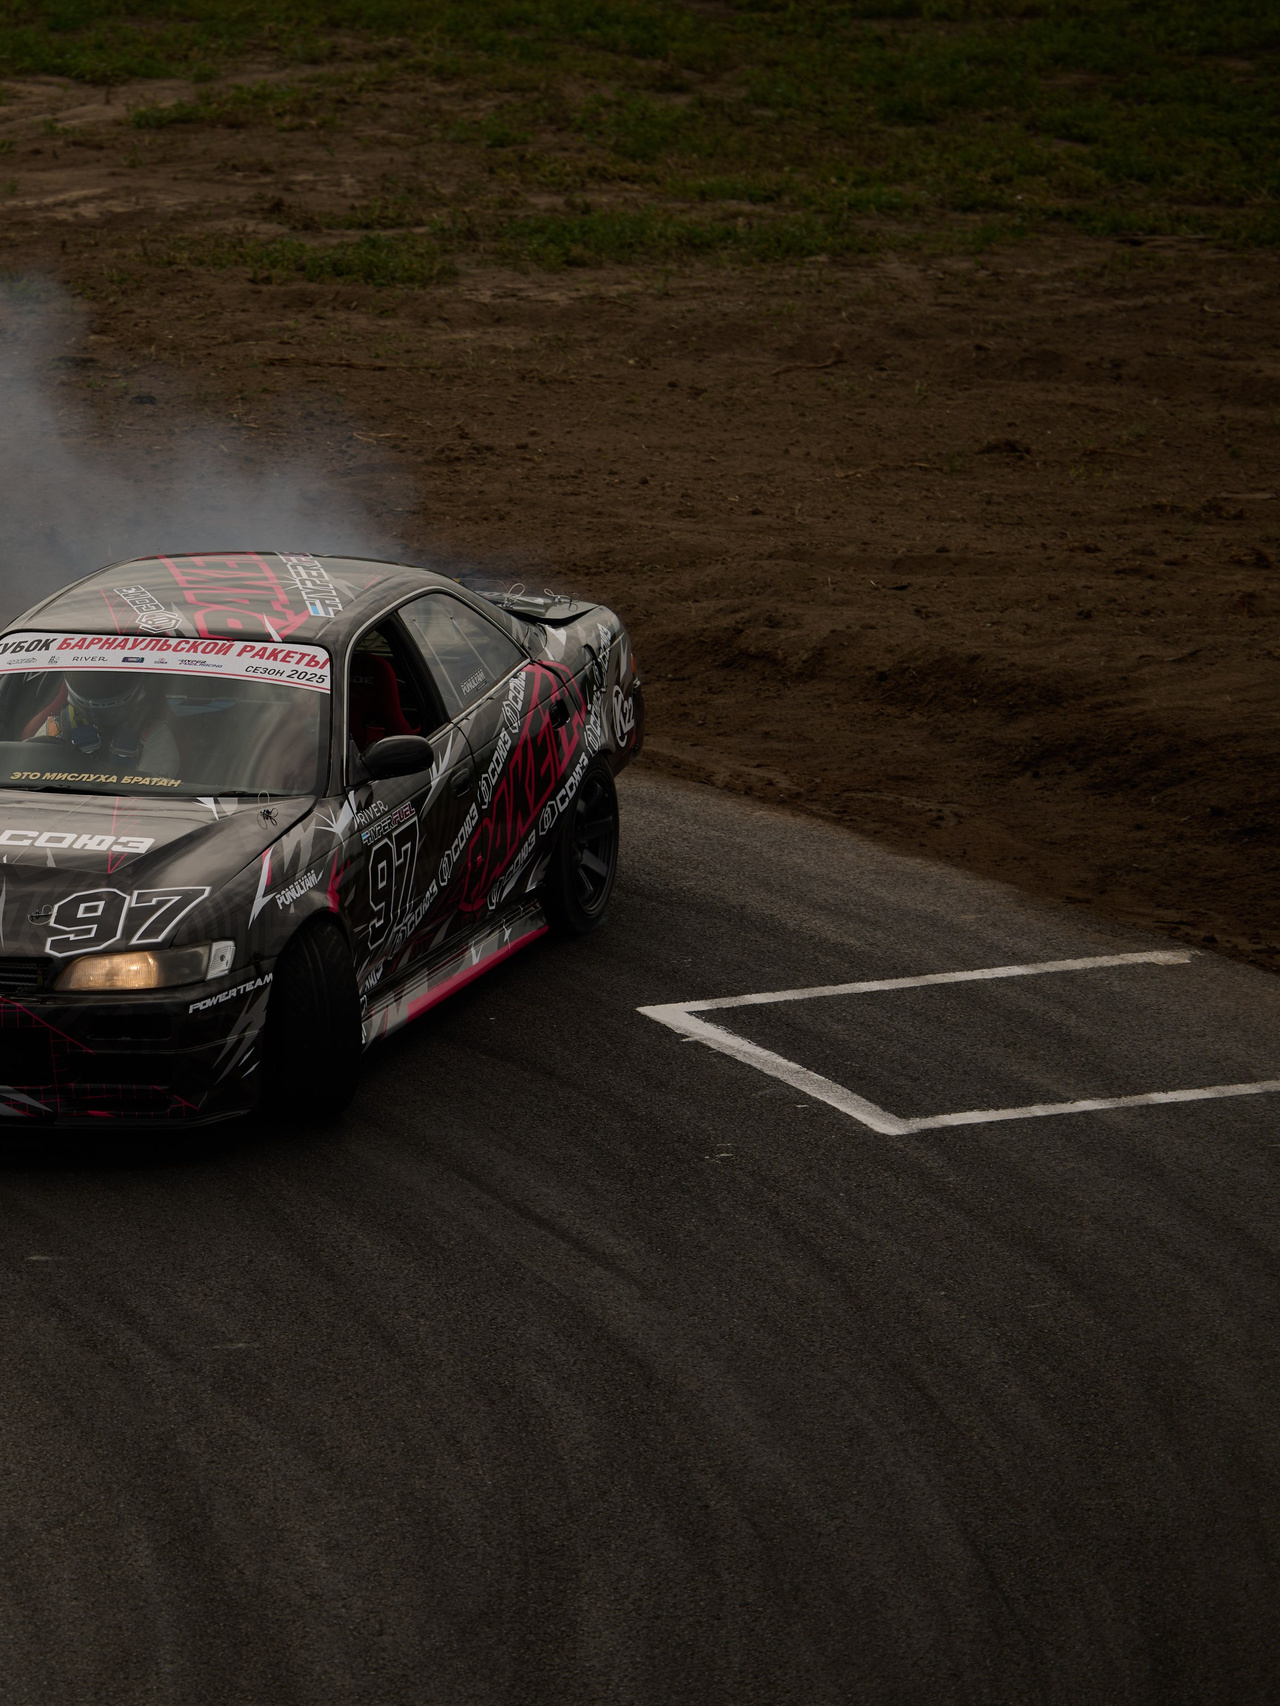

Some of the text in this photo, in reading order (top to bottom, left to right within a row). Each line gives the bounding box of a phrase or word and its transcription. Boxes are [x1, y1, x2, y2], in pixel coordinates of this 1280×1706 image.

[56, 637, 235, 656] БАРНАУЛЬСКОЙ
[236, 644, 331, 670] РАКЕТЫ
[245, 665, 328, 684] СЕЗОН 2025
[9, 771, 182, 788] ЭТО МИСЛУХА БРАТАН
[358, 800, 389, 826] RIVER
[368, 815, 420, 951] 97
[44, 886, 213, 958] 97
[188, 972, 274, 1015] POWERTEAM
